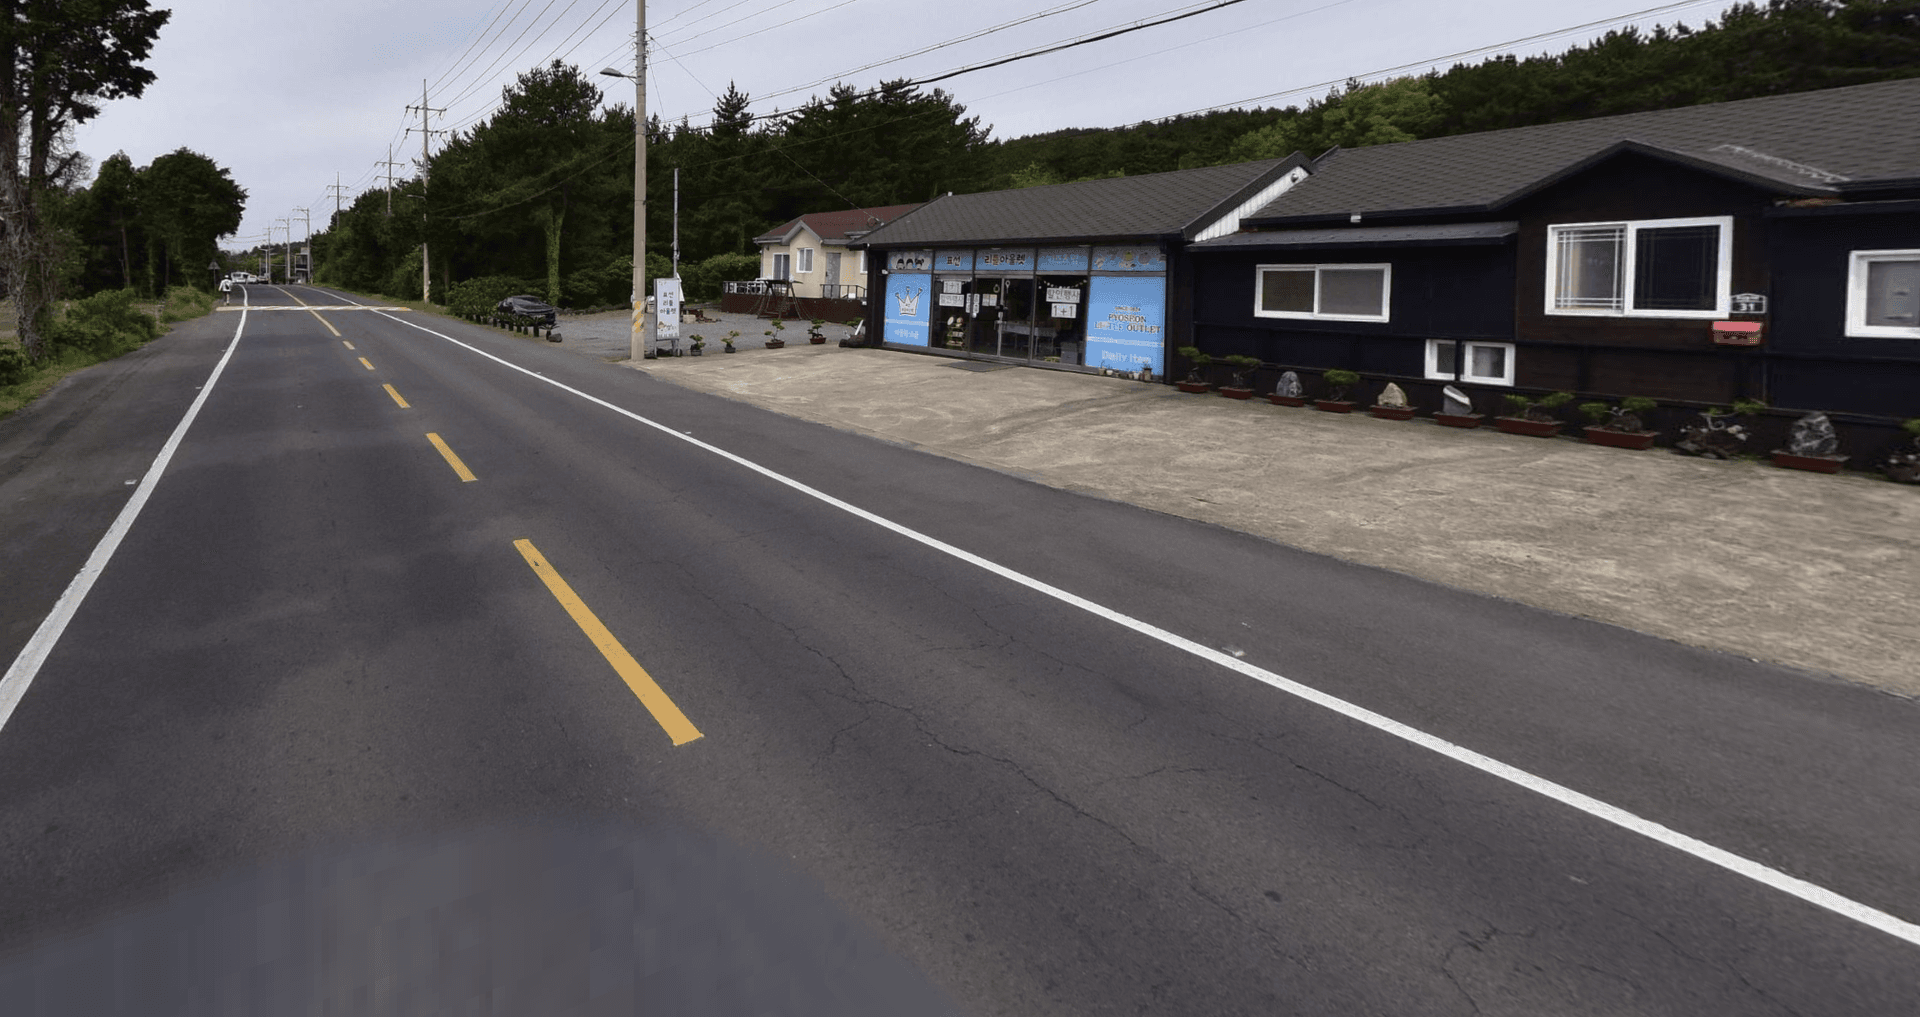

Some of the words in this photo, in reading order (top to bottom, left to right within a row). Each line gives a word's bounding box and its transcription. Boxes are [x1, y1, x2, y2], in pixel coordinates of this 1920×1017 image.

[946, 256, 961, 267] 표선
[984, 253, 1026, 266] 리틀아울렛
[660, 307, 677, 315] 아울렛
[1053, 304, 1074, 317] 1+1
[1740, 303, 1755, 311] 31
[1108, 313, 1147, 323] PYOSEON
[1126, 324, 1162, 334] OUTLET
